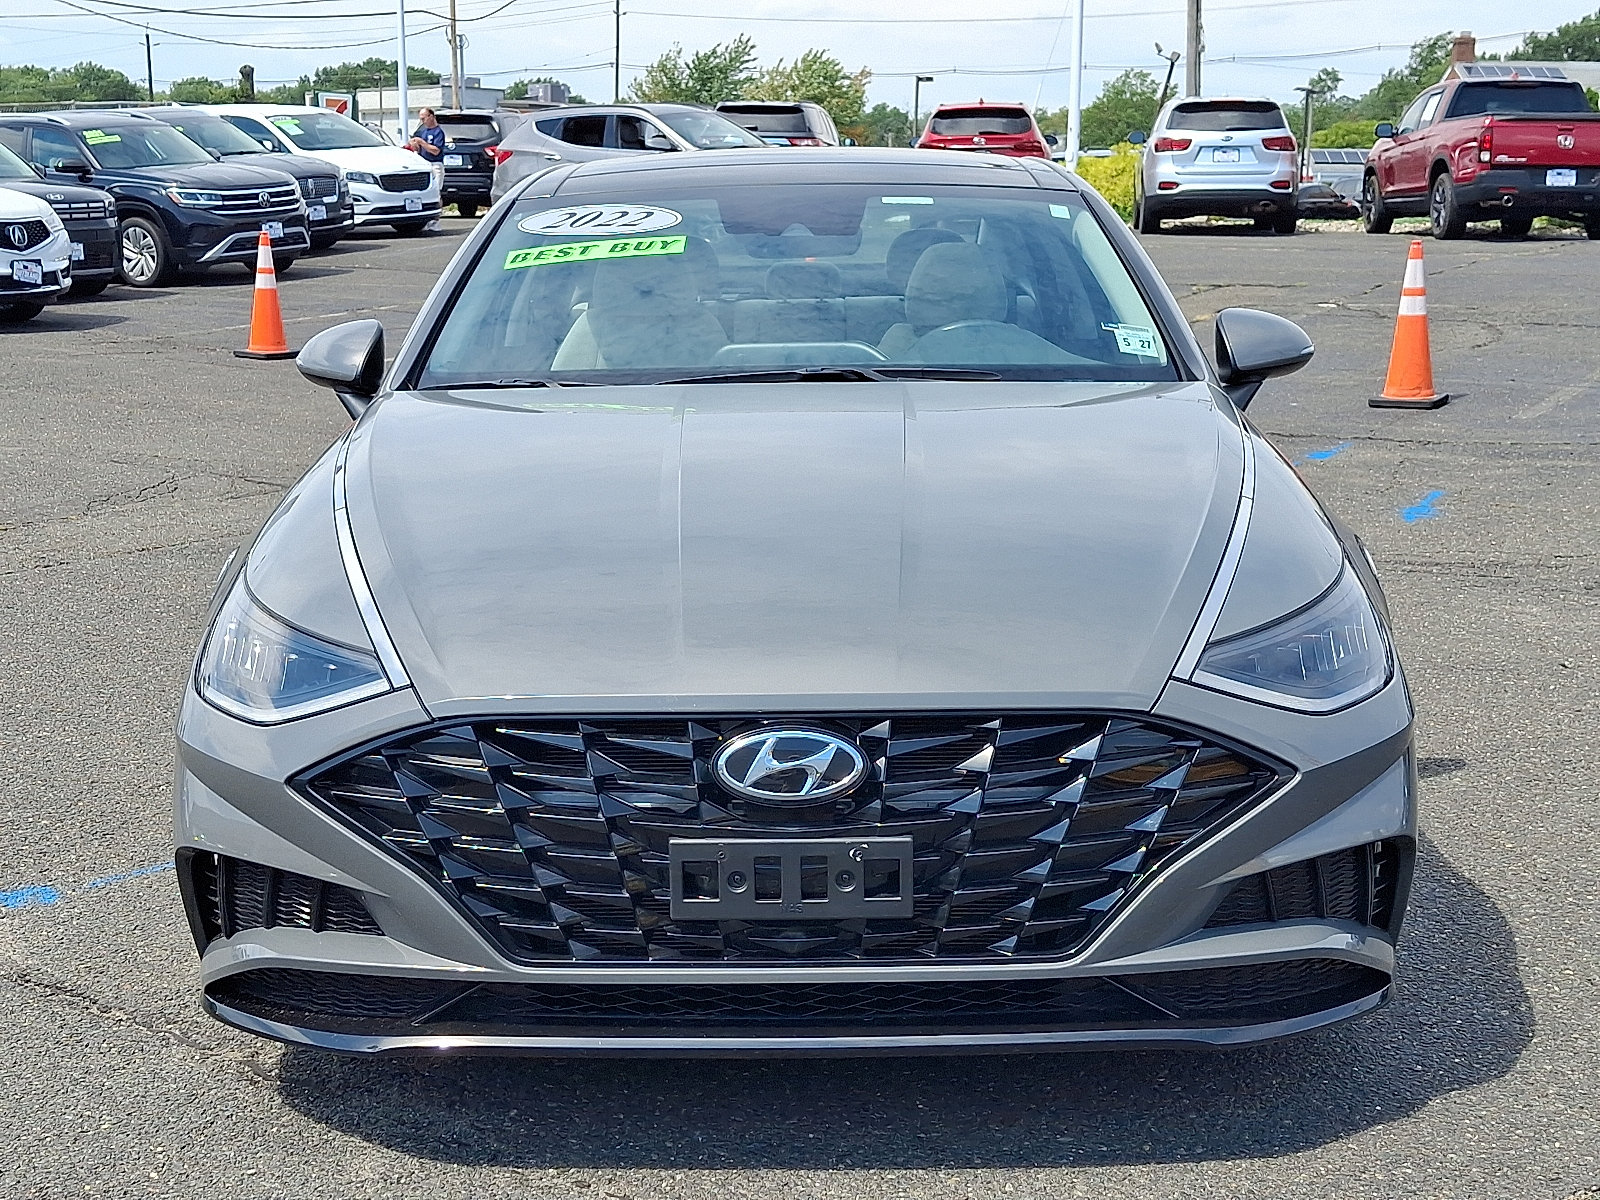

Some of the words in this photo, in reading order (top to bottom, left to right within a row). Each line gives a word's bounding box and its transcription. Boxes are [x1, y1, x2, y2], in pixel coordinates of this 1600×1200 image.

[538, 210, 655, 230] 2022
[509, 244, 599, 264] BEST
[608, 239, 682, 254] BUY
[1122, 337, 1131, 347] 5
[1138, 339, 1151, 350] 27
